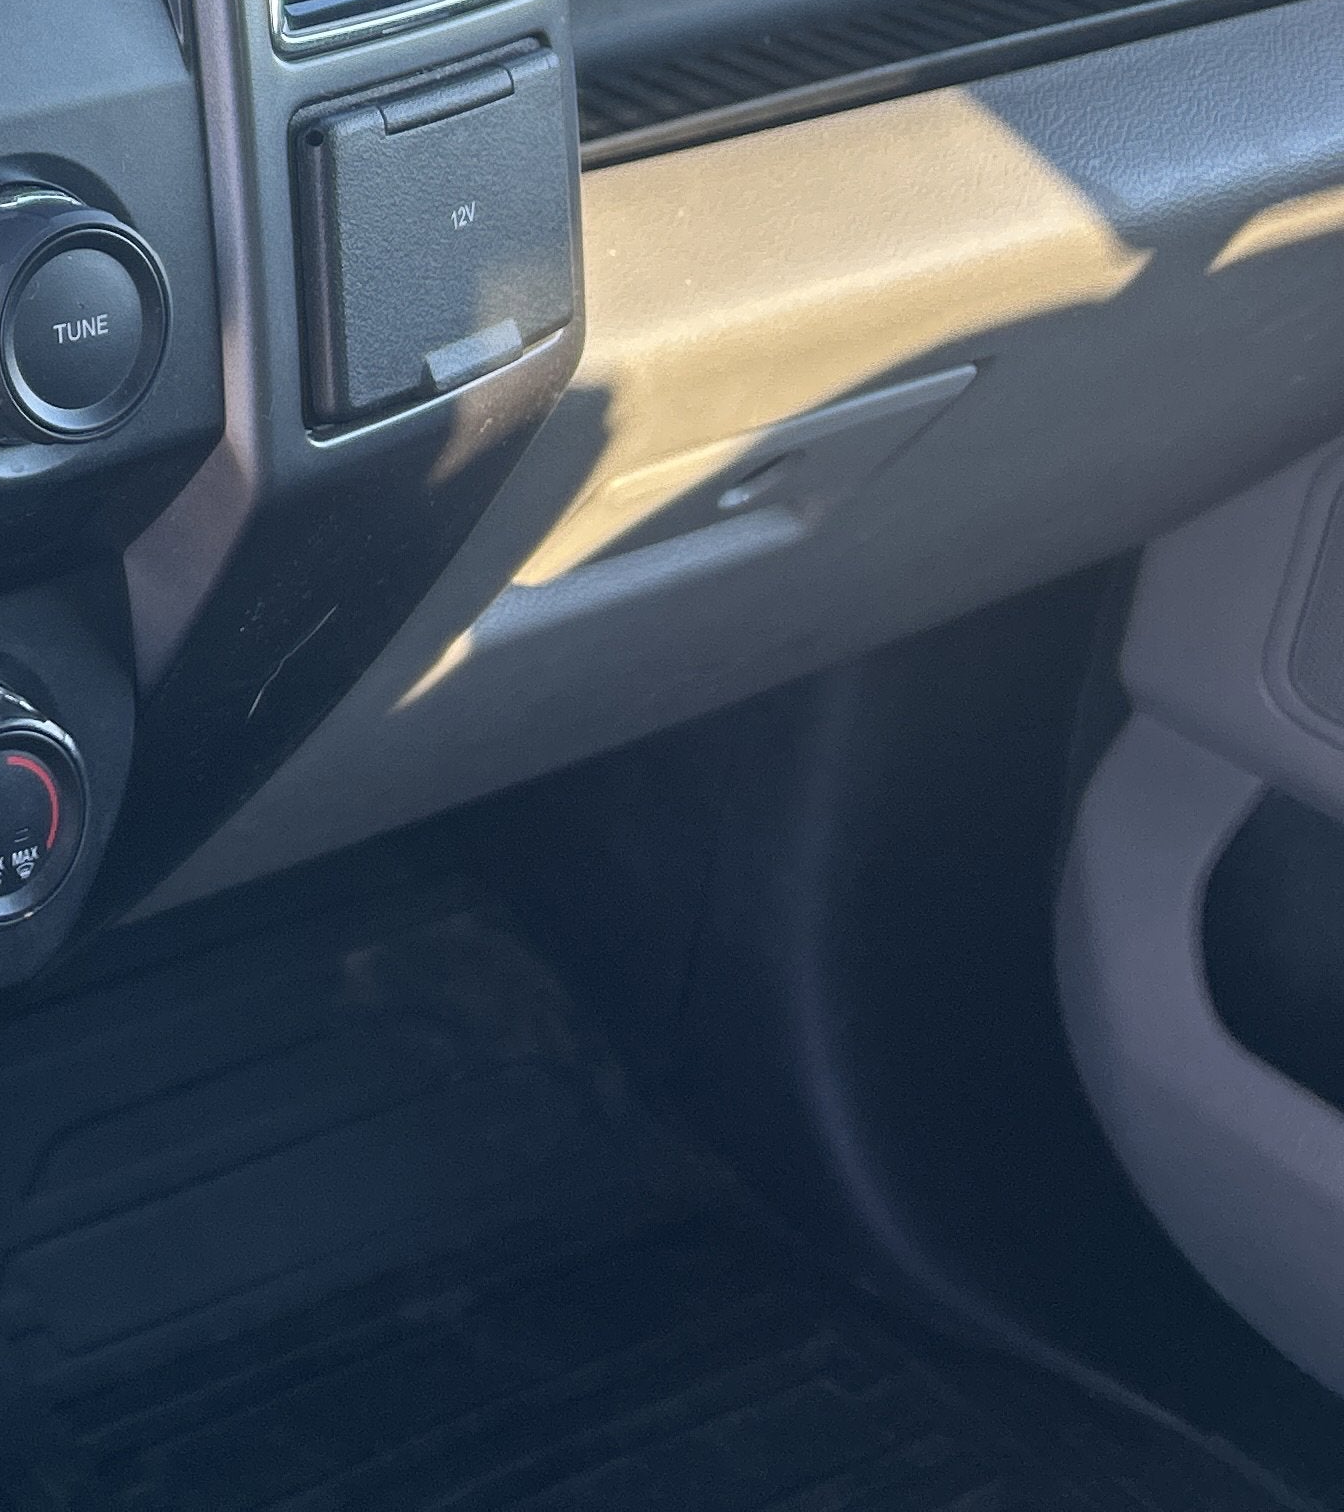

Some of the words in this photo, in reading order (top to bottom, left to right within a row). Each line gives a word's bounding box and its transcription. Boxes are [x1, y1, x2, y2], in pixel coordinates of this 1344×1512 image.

[451, 200, 476, 230] 12V
[52, 313, 109, 344] TUNE
[11, 845, 39, 867] MAX
